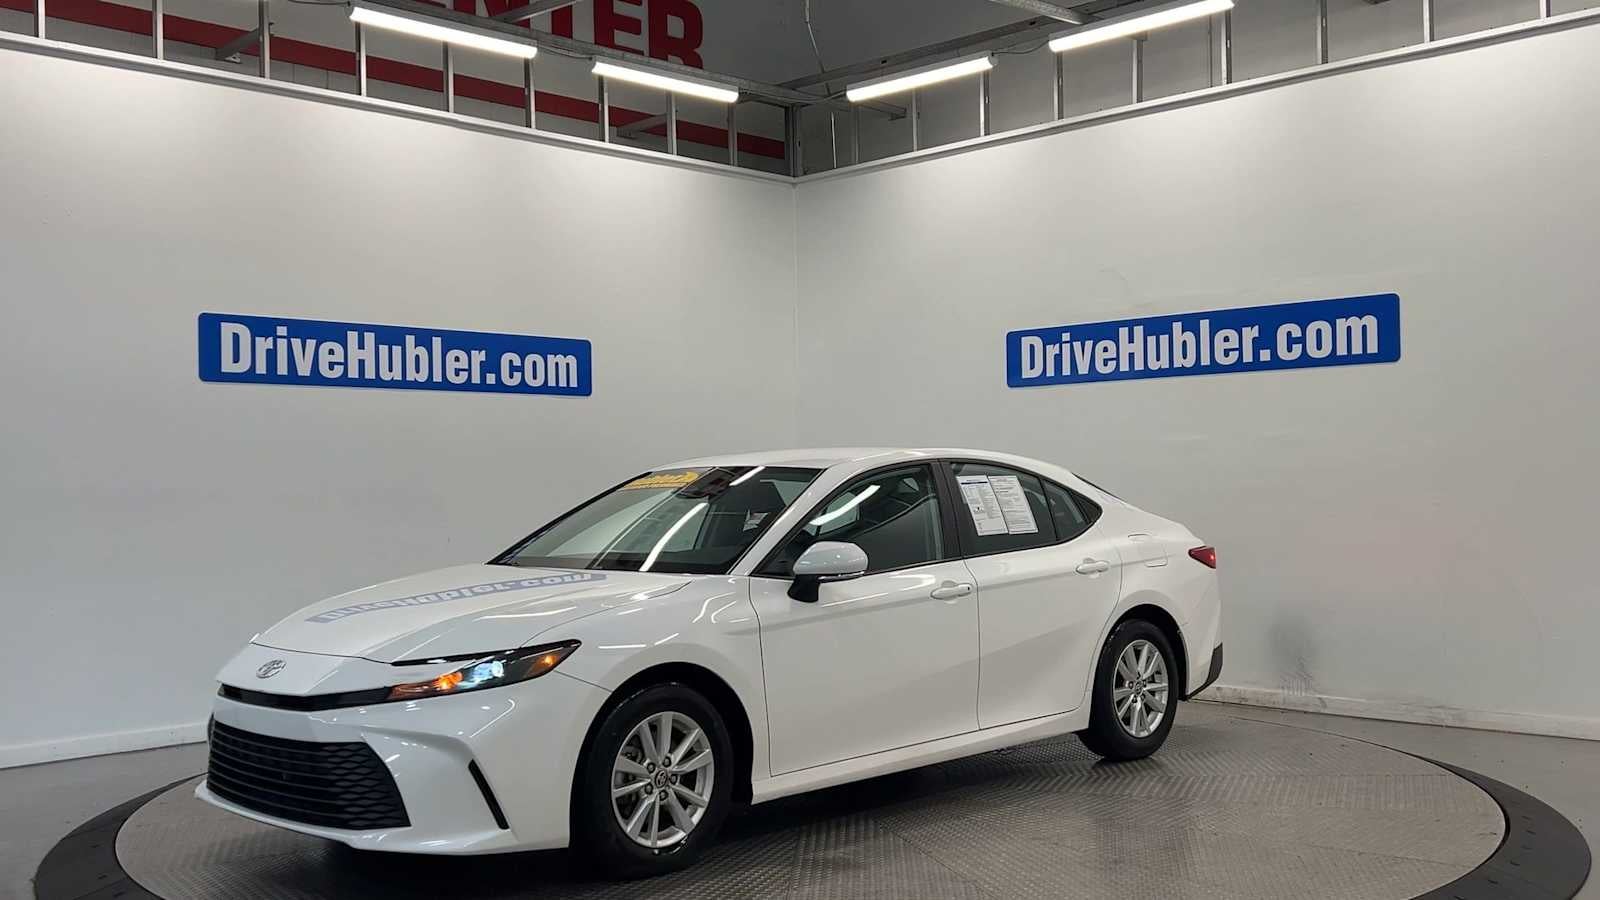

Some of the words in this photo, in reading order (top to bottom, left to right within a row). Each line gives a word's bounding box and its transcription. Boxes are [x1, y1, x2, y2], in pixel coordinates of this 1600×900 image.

[386, 0, 703, 69] TER
[220, 321, 578, 388] DriveHubler.com
[1020, 314, 1379, 379] DriveHubler.com
